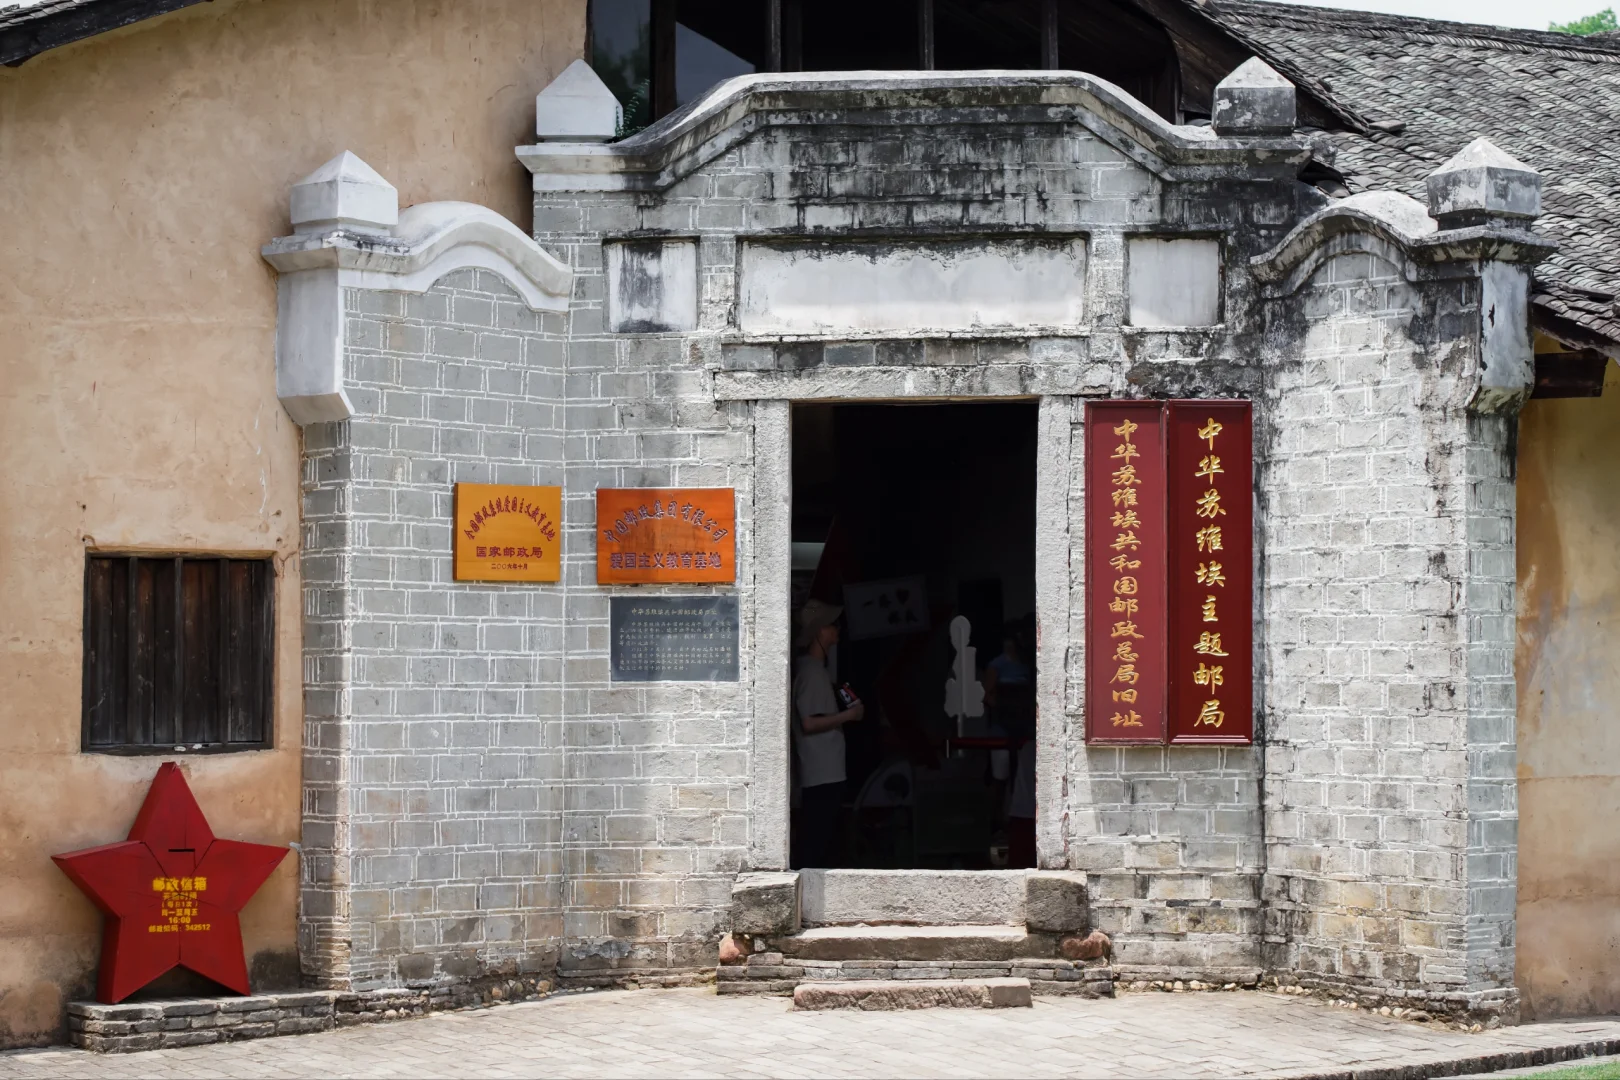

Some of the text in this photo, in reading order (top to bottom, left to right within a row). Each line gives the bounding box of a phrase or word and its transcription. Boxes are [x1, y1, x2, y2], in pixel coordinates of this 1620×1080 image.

[603, 500, 728, 542] 中国邮政集团有限公司
[476, 546, 543, 558] 国家邮政局
[610, 552, 722, 569] 爱国主义教育基地
[1108, 419, 1144, 727] 中华苏维埃共和国邮政总局旧址
[1193, 417, 1229, 728] 中华苏维埃主题邮局
